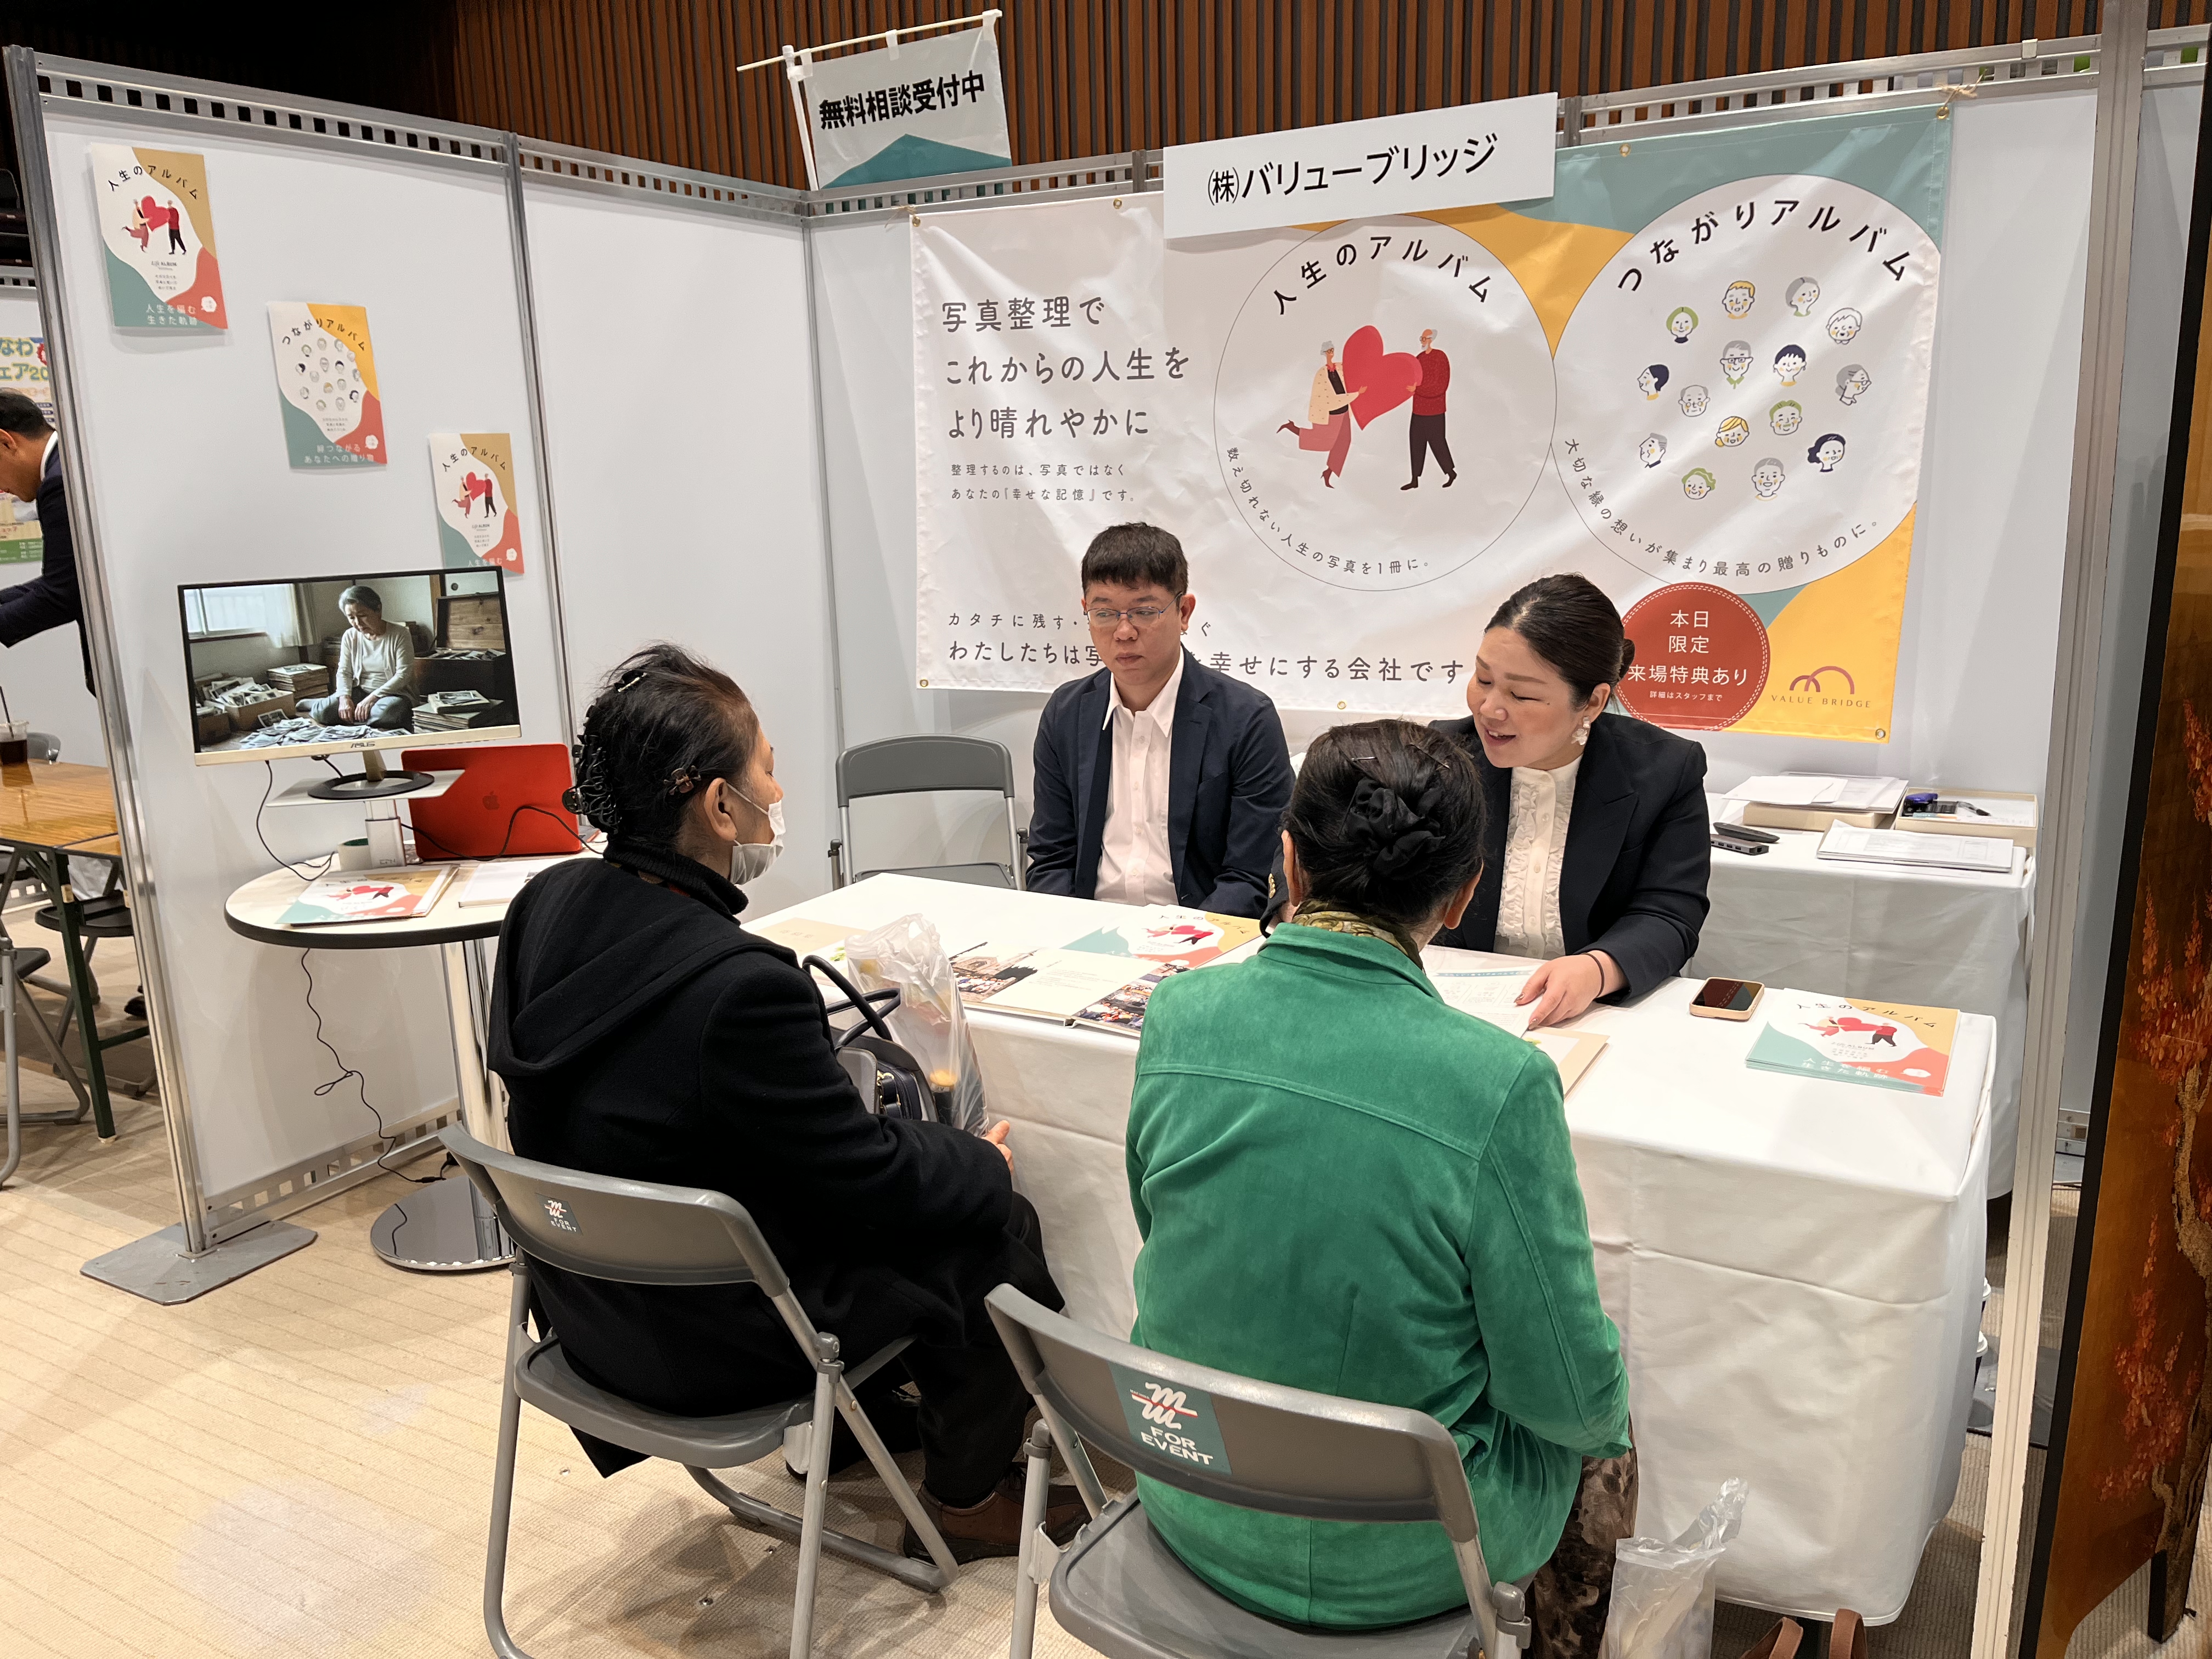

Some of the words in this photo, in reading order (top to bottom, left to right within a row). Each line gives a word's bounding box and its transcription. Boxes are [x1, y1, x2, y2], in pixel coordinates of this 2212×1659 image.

[819, 69, 985, 129] 無料相談受付中
[106, 165, 199, 200] 人生のアルバム
[1617, 199, 1911, 291] つながりアルバム
[1272, 236, 1496, 315] 人生のアルバム
[942, 296, 1104, 332] 写真整理で
[282, 318, 365, 351] つながりアルバム
[946, 347, 1189, 385] これからの人生を
[949, 406, 1148, 439] より晴れやかに
[442, 446, 506, 472] 人生のアルバム
[951, 464, 1125, 476] 整理するのは、写真ではなく
[1227, 446, 1429, 575] 数え切れない人生の写真を1冊に。
[1564, 438, 1877, 577] 大切な縁の想いが集まり最高の贈りものに。
[1670, 610, 1709, 628] 本日
[1668, 635, 1709, 653] 限定
[1627, 664, 1747, 686] 来場特典あり
[1650, 691, 1723, 702] 詳細はスタッフまで
[1771, 695, 1813, 704] VALUE
[1822, 698, 1871, 708] BRIDGE
[1797, 1003, 1937, 1028] 人生のアルバム
[1141, 1432, 1213, 1465] EVENT
[1150, 1426, 1197, 1451] FOR
